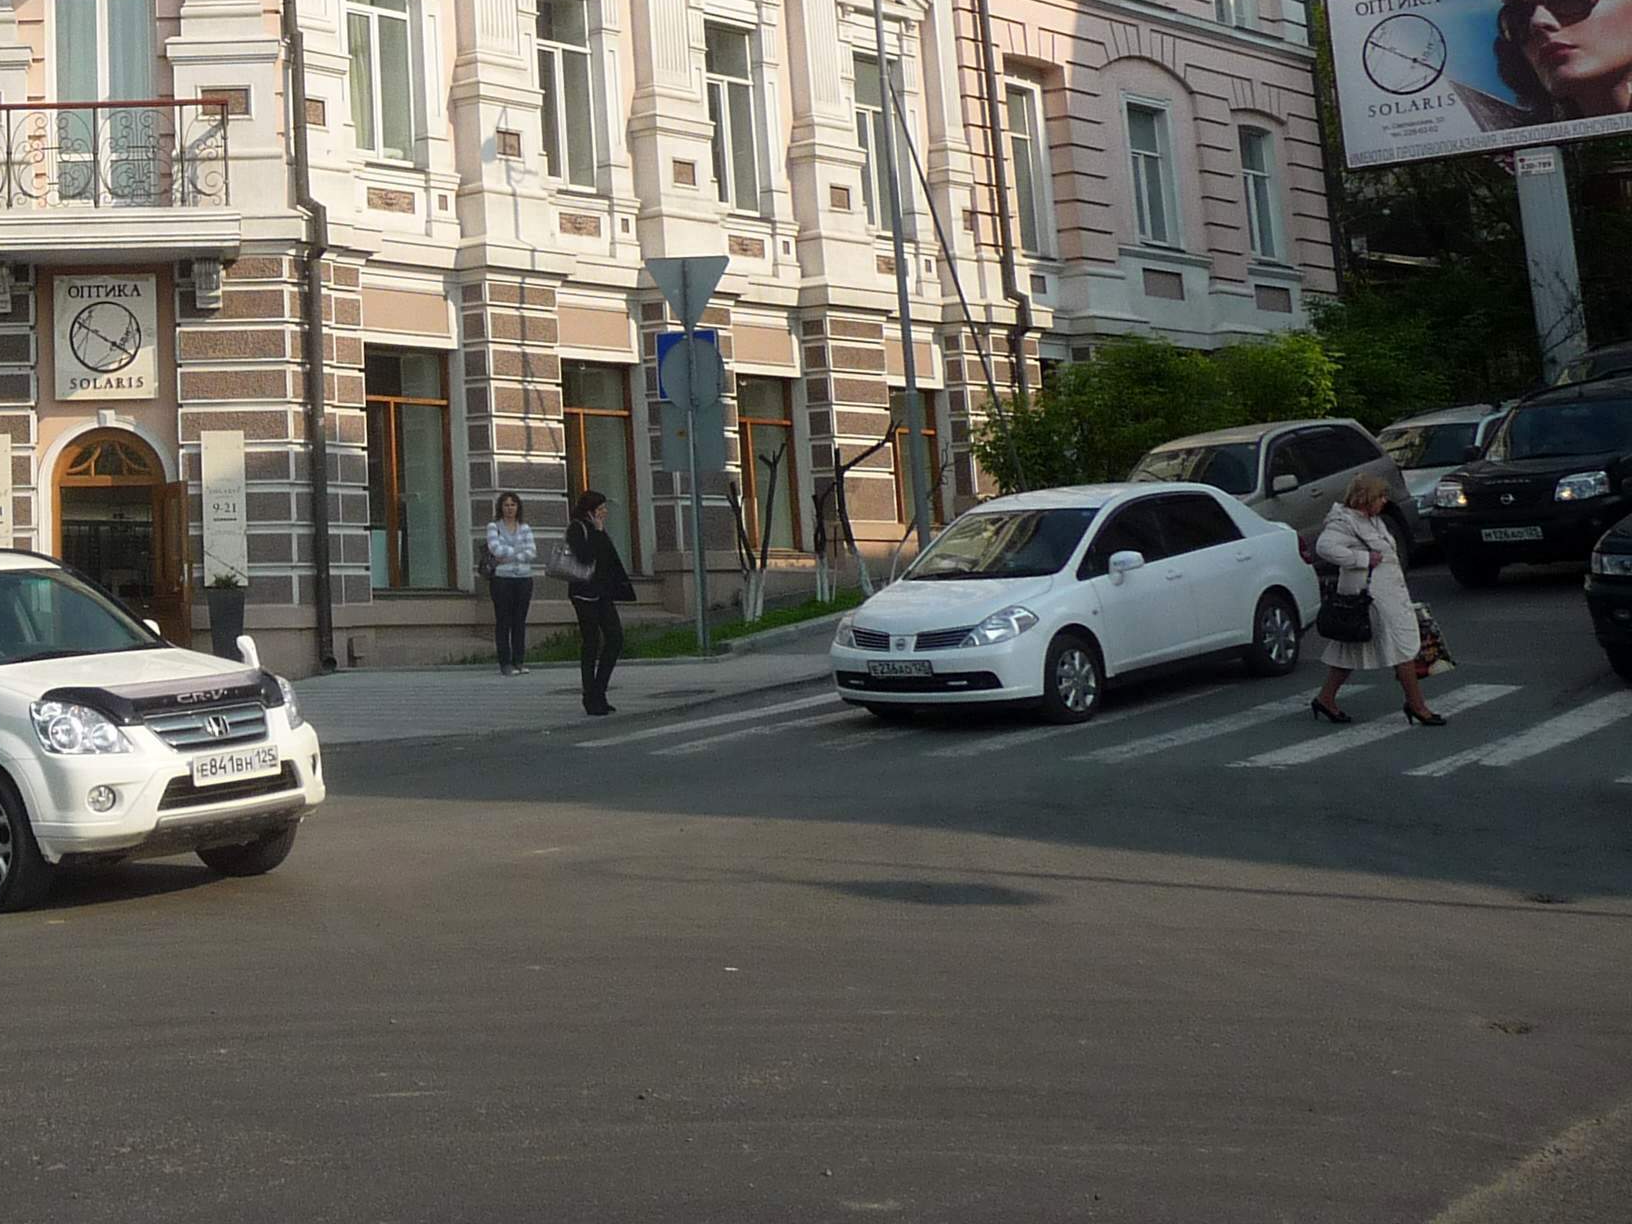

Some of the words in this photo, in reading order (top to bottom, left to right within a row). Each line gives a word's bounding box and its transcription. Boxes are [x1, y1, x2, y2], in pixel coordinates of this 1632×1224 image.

[1368, 93, 1456, 117] SOLARIS
[68, 284, 141, 299] ОПТИКА
[70, 377, 144, 390] SOLARIS
[213, 503, 236, 513] 9-21
[177, 688, 223, 704] CR-V
[199, 755, 253, 777] Е841ВН
[255, 748, 275, 763] 125
